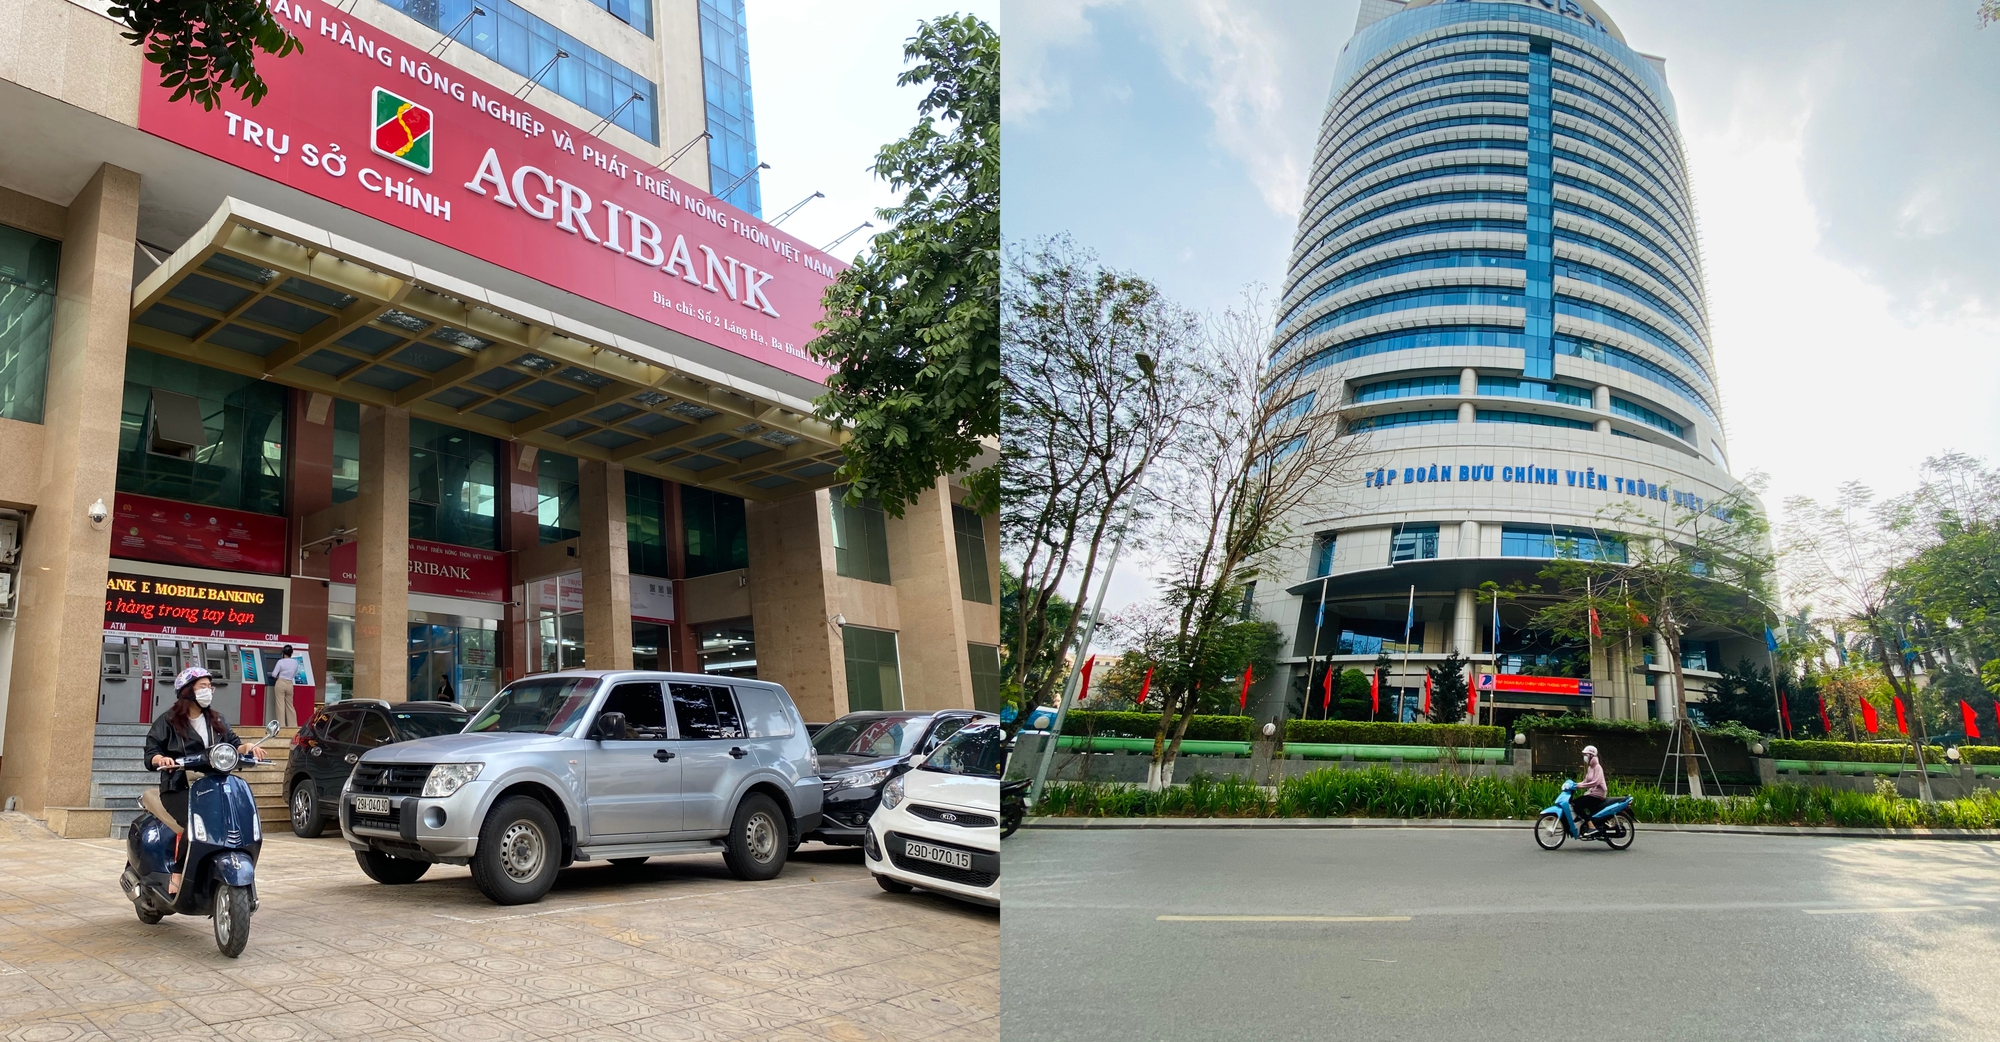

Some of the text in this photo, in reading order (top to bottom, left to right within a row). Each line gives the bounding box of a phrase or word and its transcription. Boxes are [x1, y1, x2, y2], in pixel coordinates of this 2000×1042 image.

[320, 17, 393, 67] HÀNG
[400, 56, 465, 101] NÔNG
[472, 91, 545, 138] NGHIỆP
[551, 129, 576, 155] VÀ
[582, 145, 628, 179] PHÁT
[633, 170, 680, 205] TRIỂN
[684, 195, 727, 228] NÔNG
[731, 218, 769, 249] THÔN
[771, 237, 800, 263] VIỆT
[804, 254, 834, 279] NAM
[224, 111, 451, 221] TRỤ SỞ CHÍNH
[464, 147, 781, 319] AGRIBANK
[653, 291, 671, 309] Địa
[675, 303, 696, 317] chỉ:
[697, 308, 712, 324] Số
[714, 315, 721, 327] 2
[723, 318, 748, 340] Láng
[771, 337, 783, 351] Ba
[1365, 467, 1397, 489] TẬP
[1403, 463, 1451, 484] ĐOÀN
[1459, 463, 1494, 481] BƯU
[1502, 464, 1558, 486] CHÍNH
[1566, 467, 1608, 491] VIỄN
[1615, 477, 1669, 502] THÔNG
[141, 581, 150, 593] E
[115, 598, 155, 619] hàng
[158, 603, 199, 623] trong
[202, 608, 225, 624] tay
[228, 608, 254, 625] bạn
[110, 622, 126, 630] ATM
[162, 626, 177, 634] ATM
[210, 629, 225, 637] ATM
[265, 633, 279, 641] CDM
[907, 843, 969, 867] 29D-070.15
